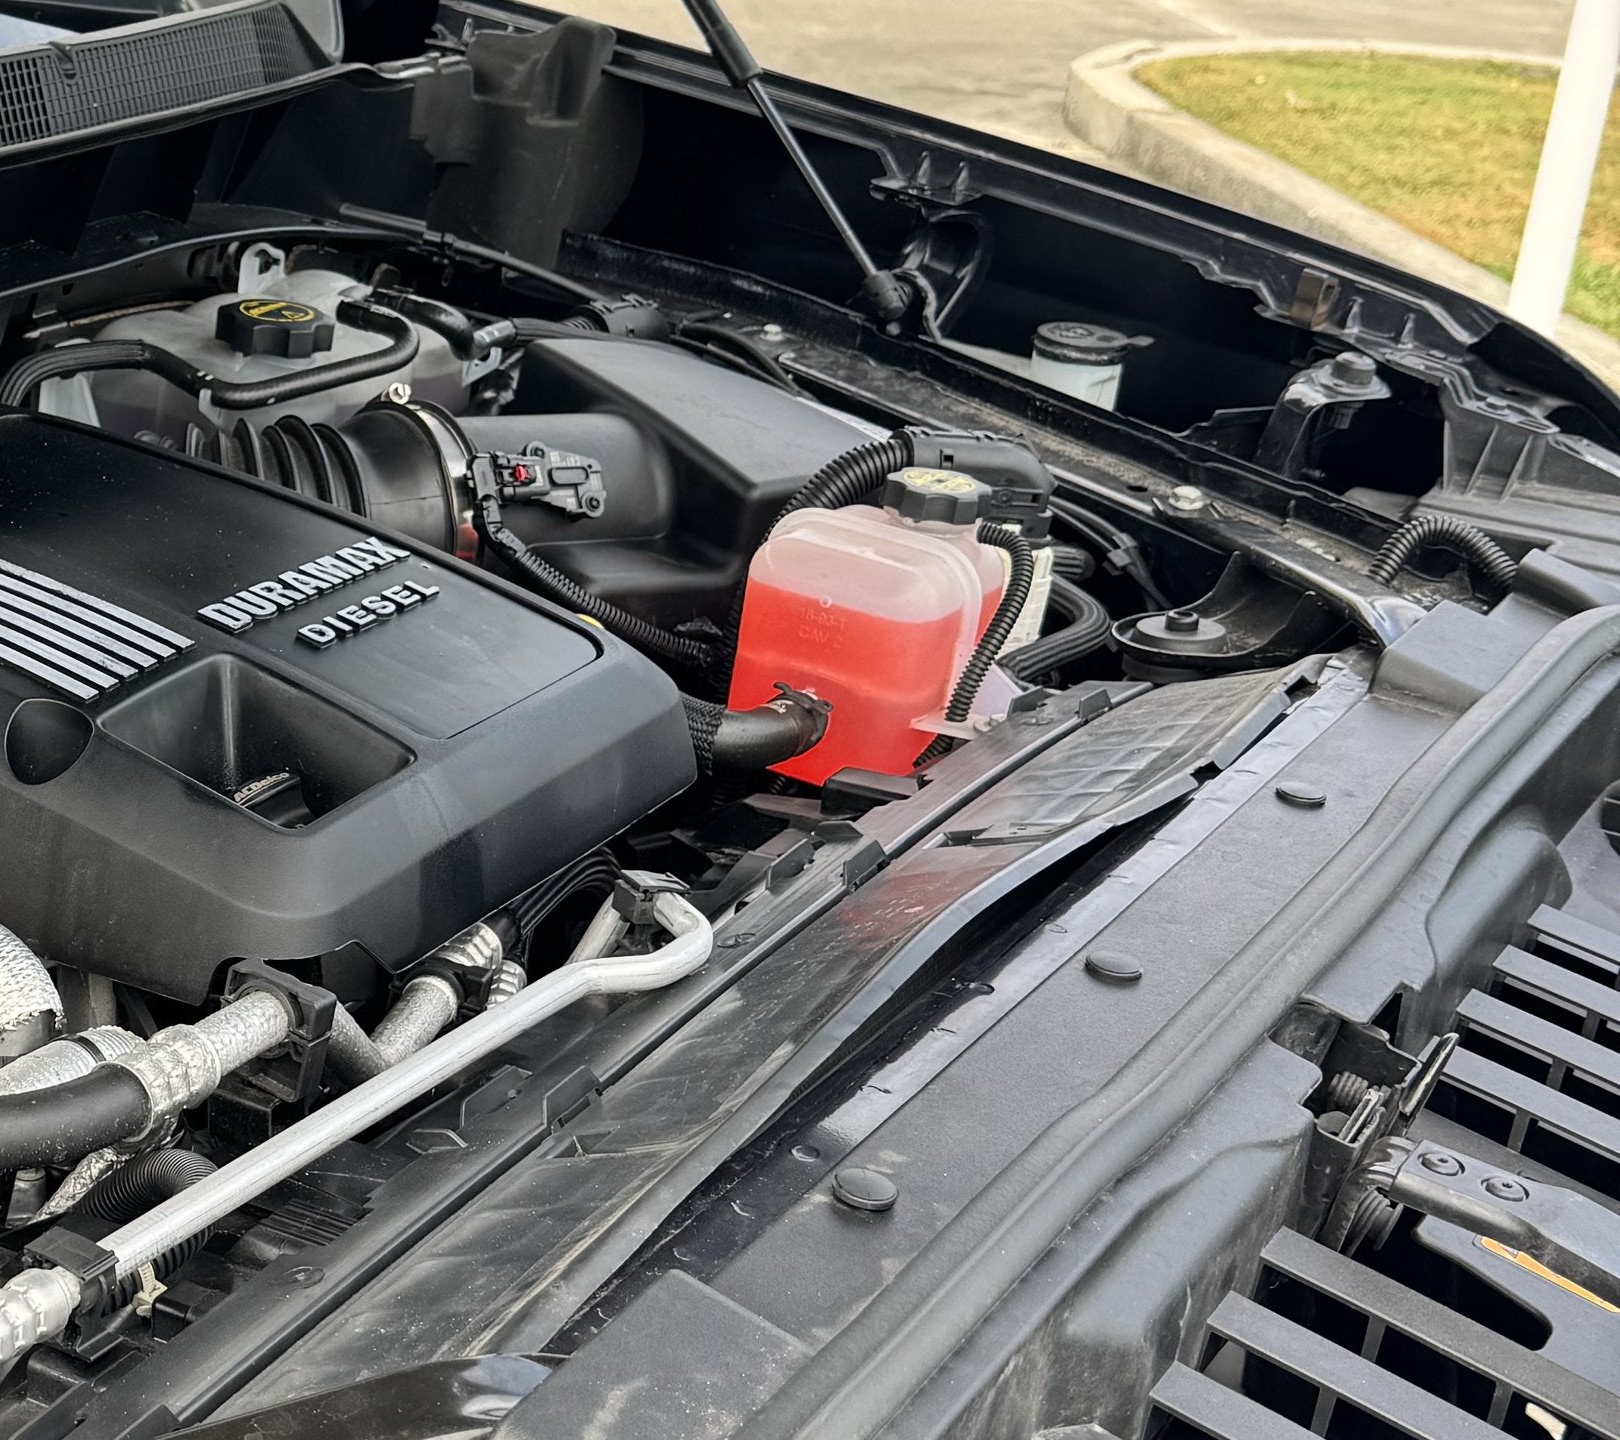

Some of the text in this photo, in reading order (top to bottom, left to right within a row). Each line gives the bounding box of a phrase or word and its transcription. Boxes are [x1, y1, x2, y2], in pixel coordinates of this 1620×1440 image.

[196, 535, 412, 634] DURAMAX
[296, 580, 441, 649] DIESEL
[233, 772, 290, 803] ACDelco
